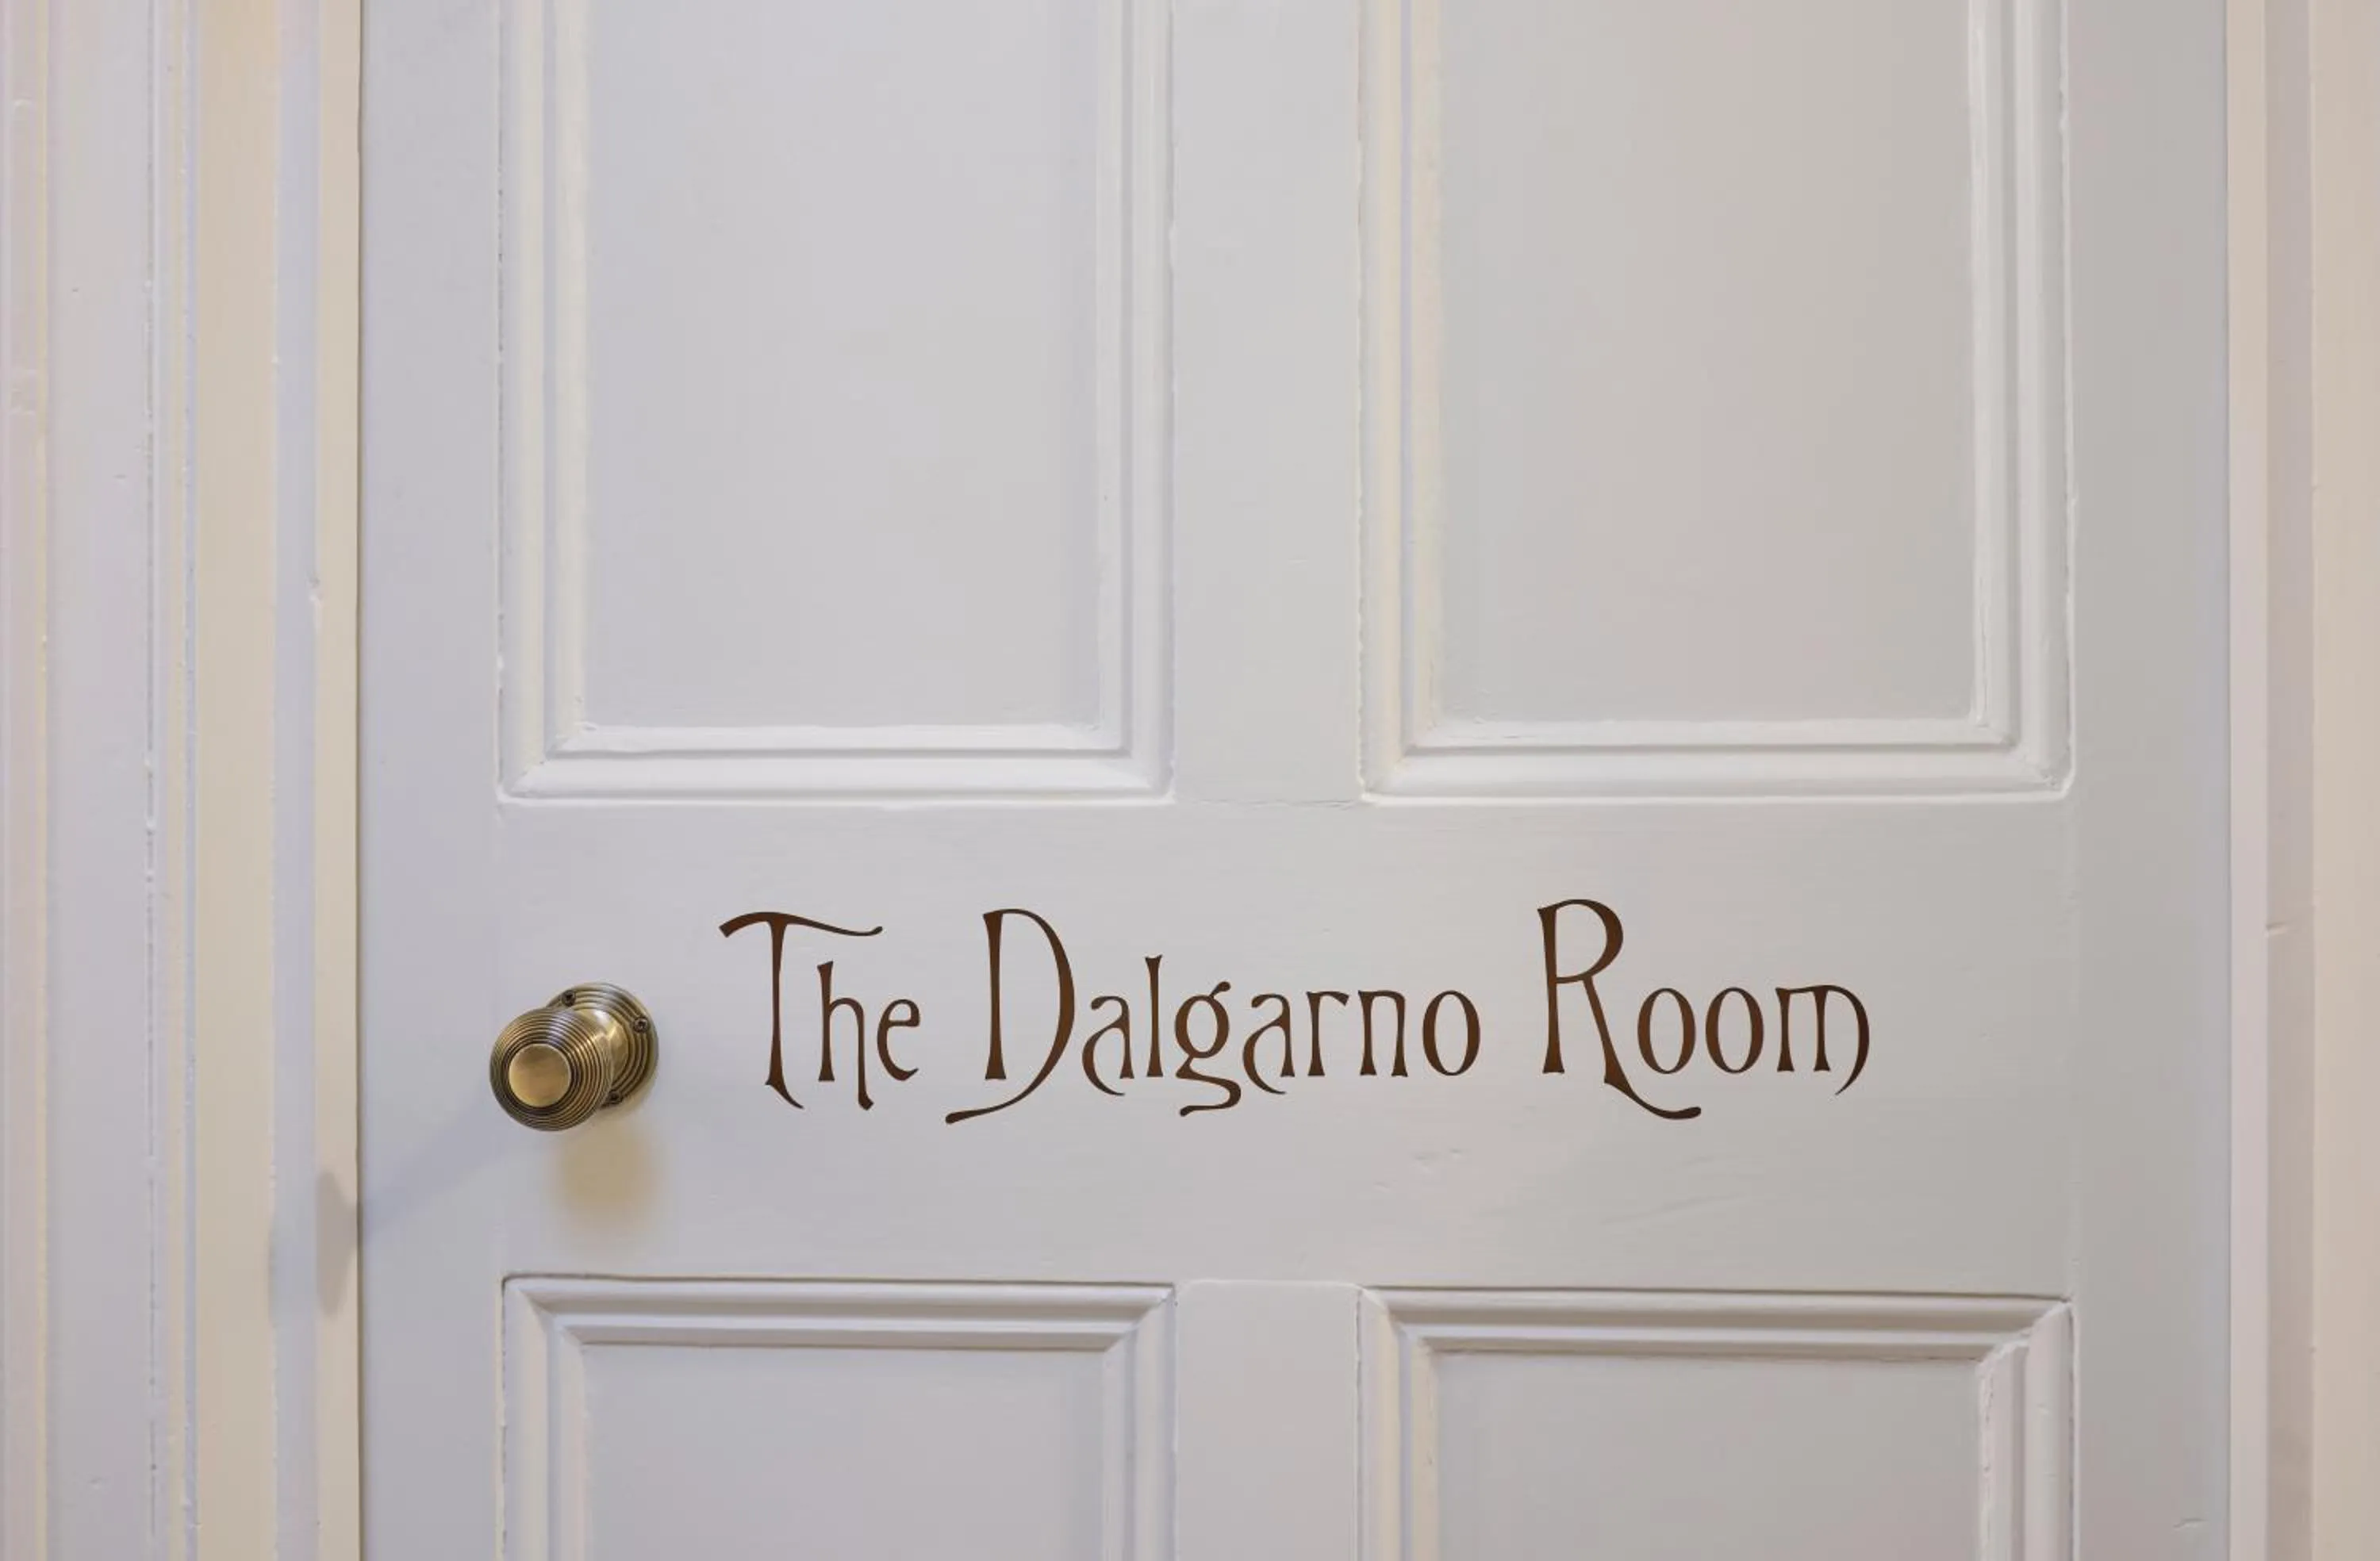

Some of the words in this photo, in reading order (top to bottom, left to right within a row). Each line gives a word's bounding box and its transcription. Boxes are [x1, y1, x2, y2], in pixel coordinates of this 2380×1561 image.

[719, 911, 920, 1111] The
[945, 908, 1480, 1125] Dalgarno
[1537, 899, 1870, 1120] Room
